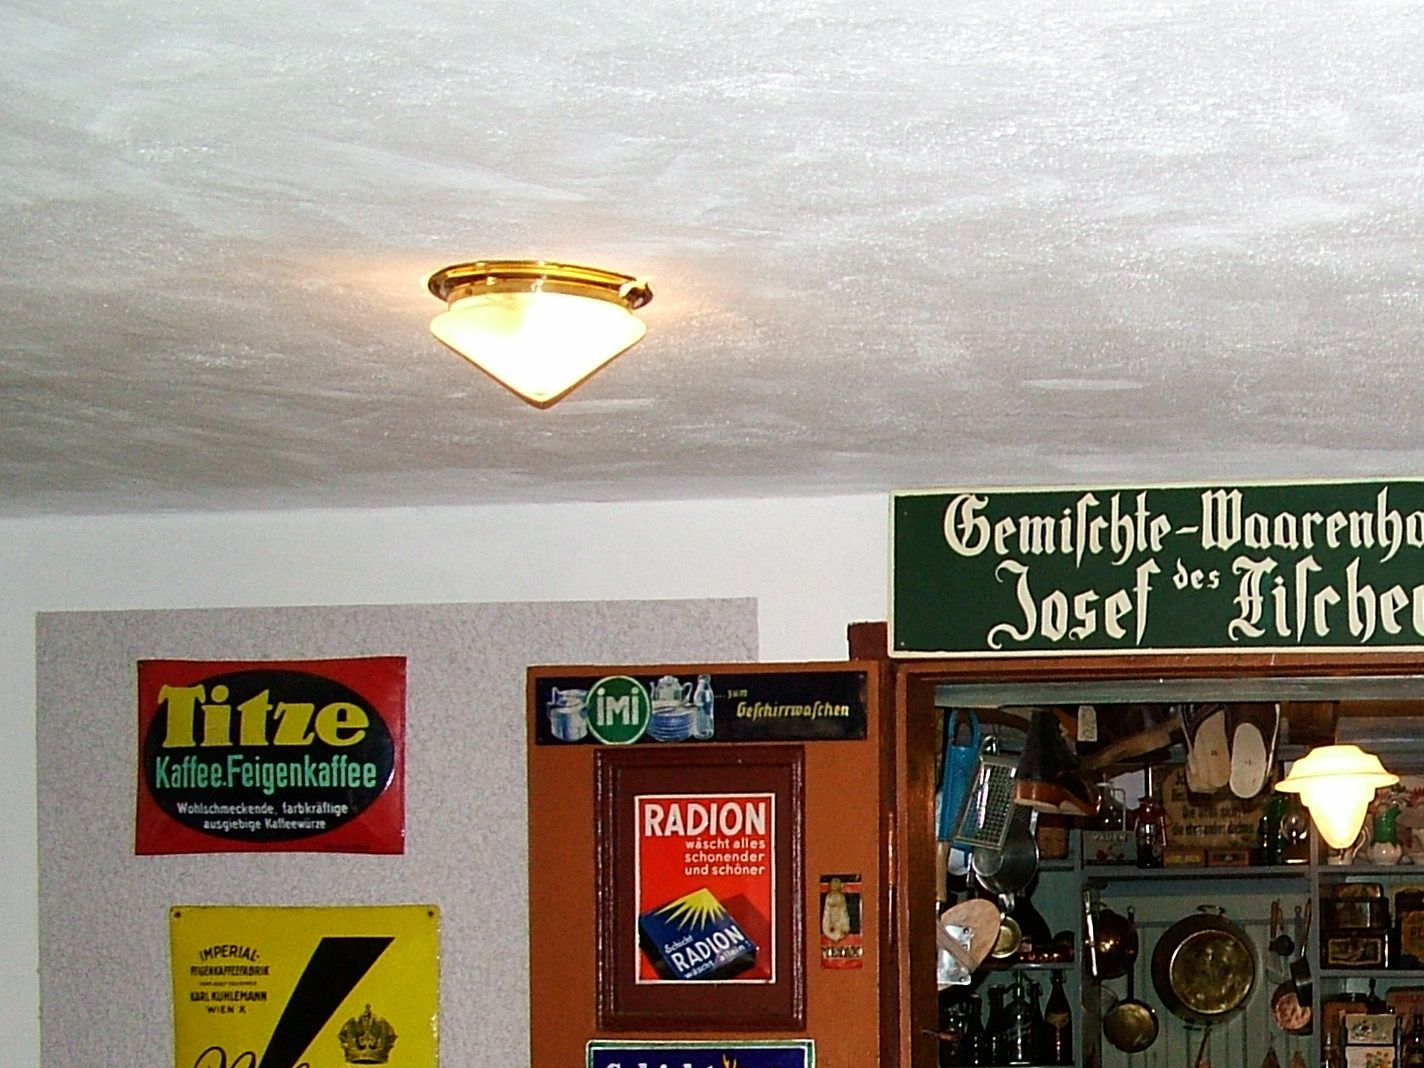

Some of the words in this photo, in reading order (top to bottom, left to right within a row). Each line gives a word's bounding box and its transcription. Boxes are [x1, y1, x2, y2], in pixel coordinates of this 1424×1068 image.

[986, 558, 1161, 649] Josef
[1172, 557, 1220, 589] des
[158, 684, 369, 748] Titze
[203, 818, 261, 832] ausgiebige
[265, 818, 326, 830] Kaffeewürze
[645, 802, 766, 836] RADION
[685, 837, 729, 849] wäscht
[733, 837, 766, 849] alles
[685, 851, 765, 863] schonender
[685, 864, 709, 875] und
[711, 863, 765, 875] schöner
[671, 924, 745, 972] RADION
